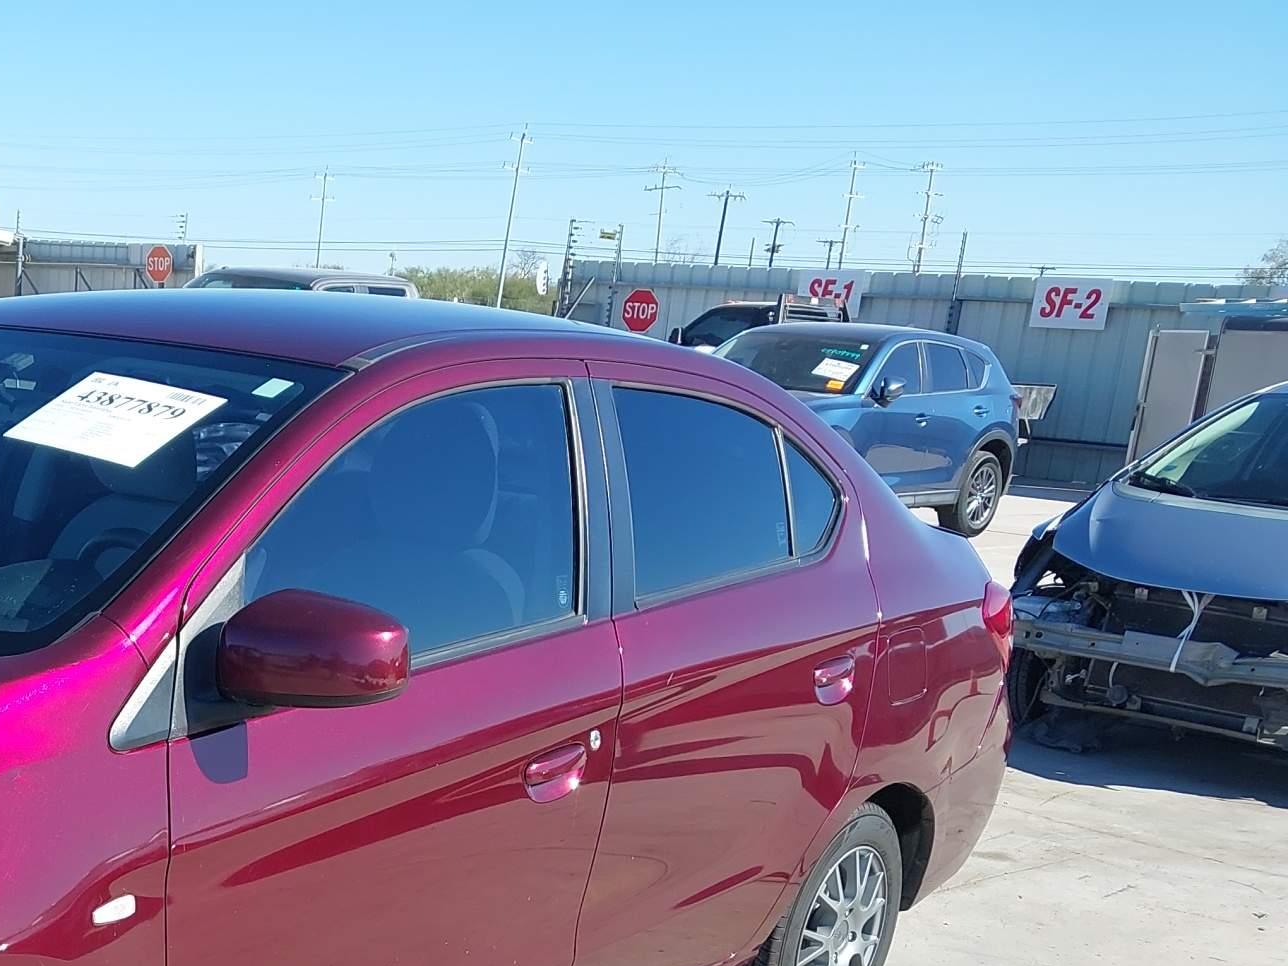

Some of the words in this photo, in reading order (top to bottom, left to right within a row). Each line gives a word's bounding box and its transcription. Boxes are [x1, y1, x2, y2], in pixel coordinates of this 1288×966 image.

[148, 257, 170, 271] STOP
[809, 278, 855, 302] SF-1
[624, 302, 656, 319] STOP
[1039, 286, 1102, 320] SF-2
[76, 389, 187, 420] 43877879
